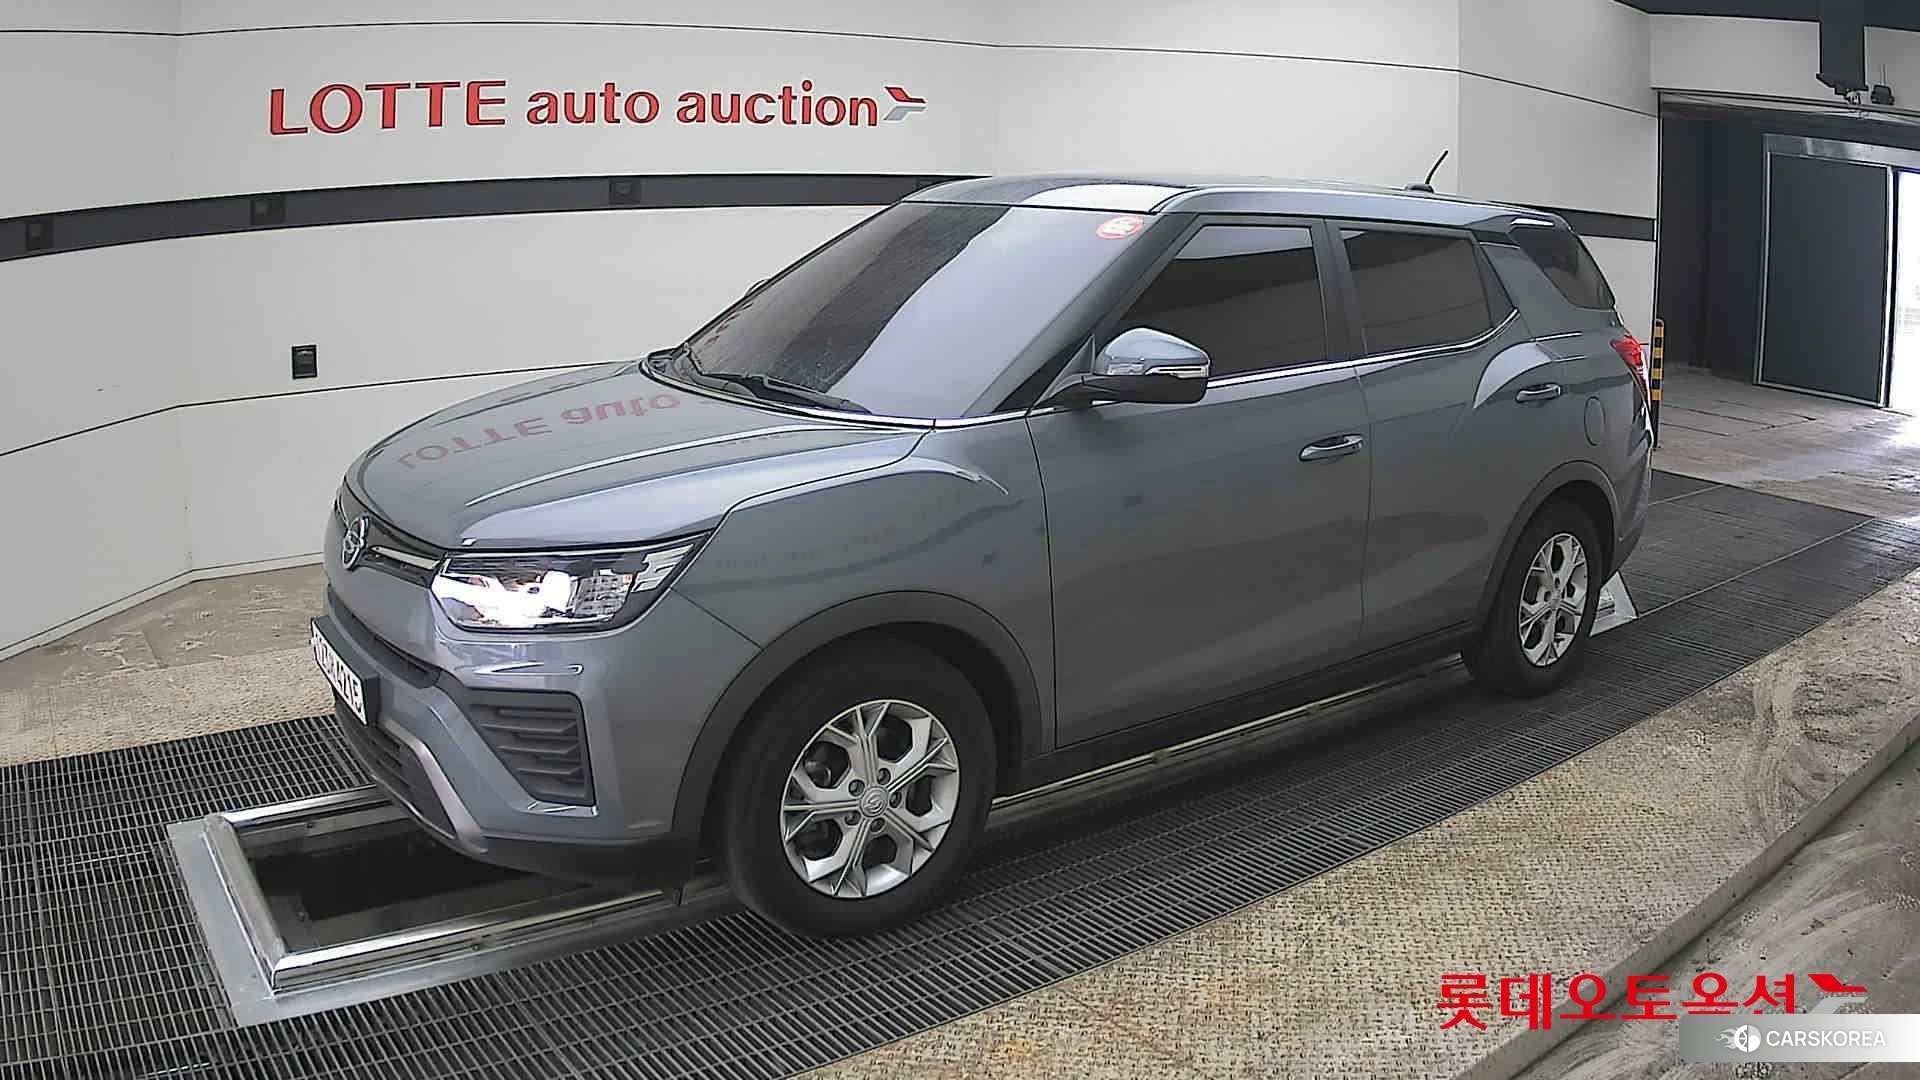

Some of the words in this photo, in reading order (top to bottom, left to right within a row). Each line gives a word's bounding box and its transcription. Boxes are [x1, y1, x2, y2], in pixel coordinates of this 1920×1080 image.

[269, 80, 507, 135] LOTTE
[526, 82, 660, 125] auto
[676, 80, 878, 127] auction
